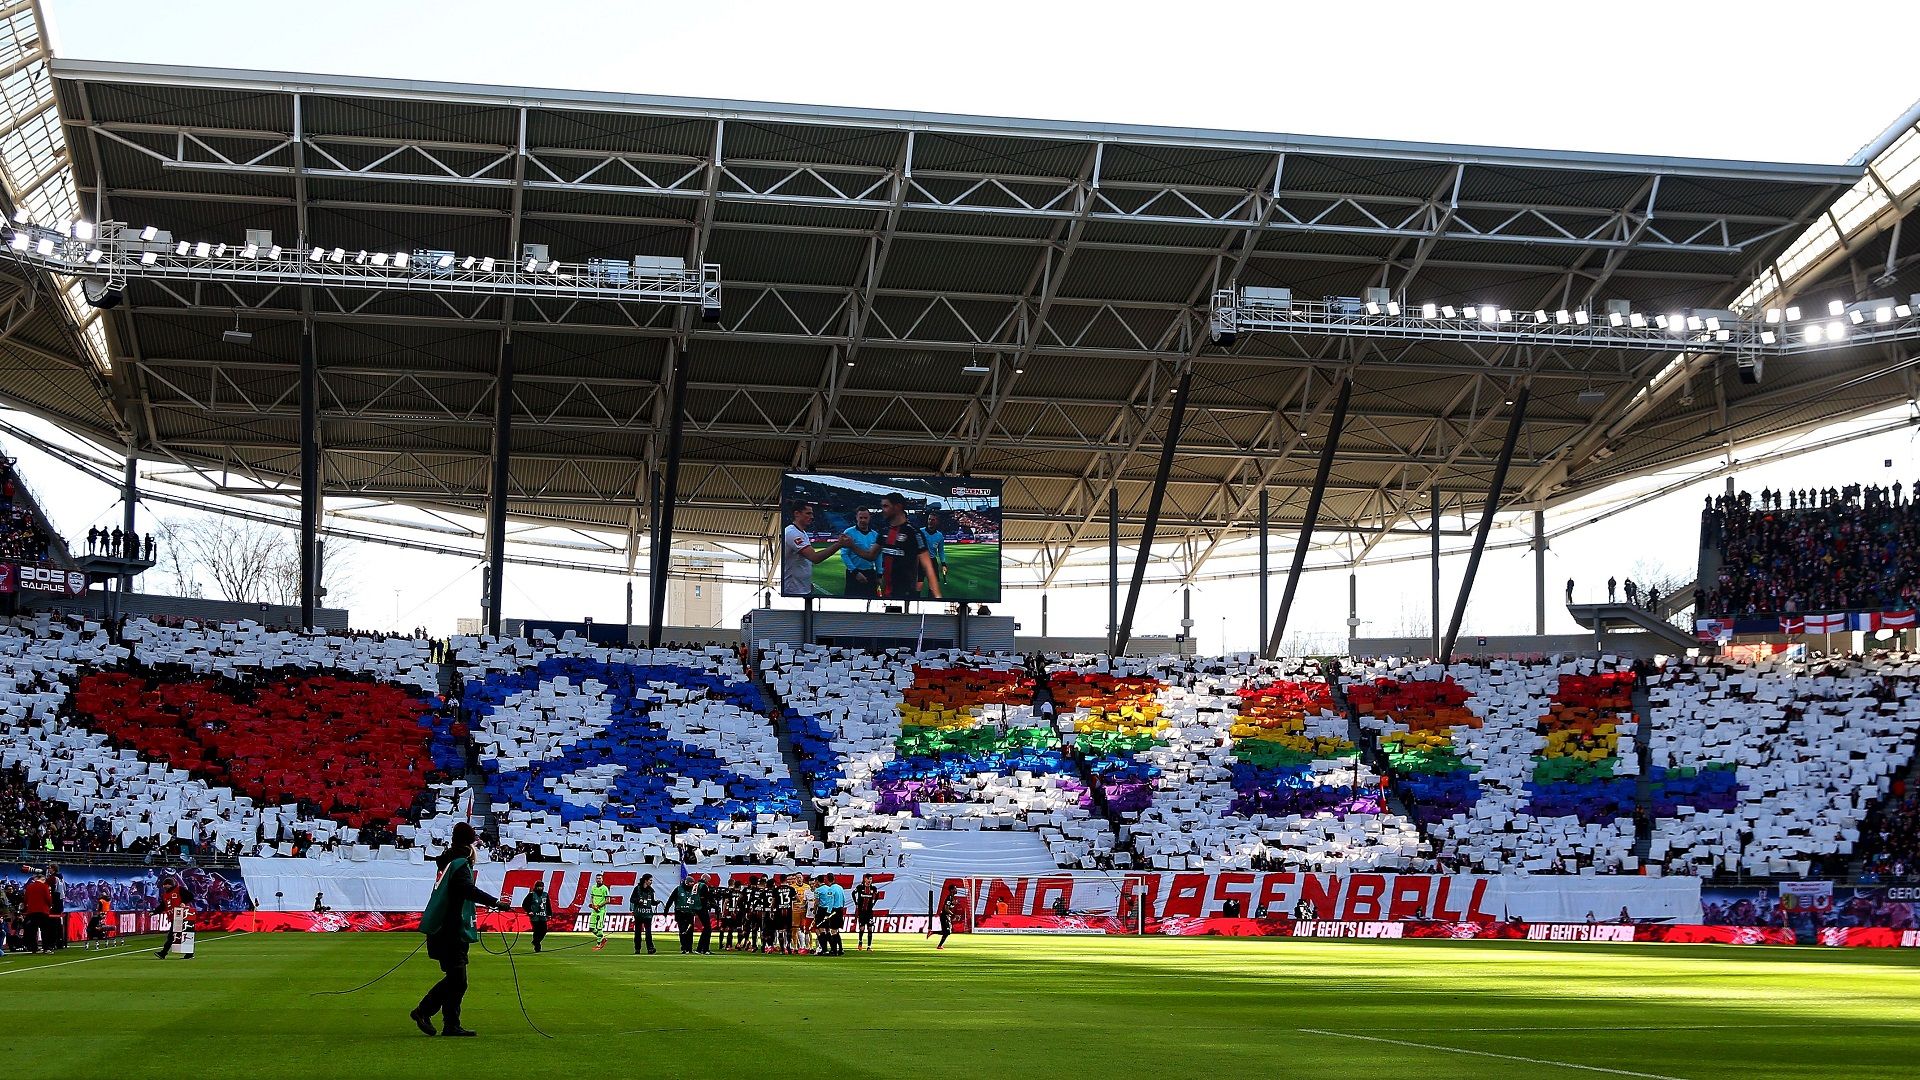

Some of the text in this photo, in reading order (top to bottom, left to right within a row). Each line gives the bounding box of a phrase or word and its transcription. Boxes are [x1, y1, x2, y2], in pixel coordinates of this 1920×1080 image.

[20, 565, 65, 583] BOS
[21, 581, 65, 592] GAURUS
[462, 868, 638, 914] OVE
[935, 873, 1074, 916] AND
[1116, 872, 1498, 923] RASENBALL
[779, 892, 791, 905] 13
[600, 915, 638, 932] GEHT'
[1293, 921, 1317, 937] AUF
[1316, 921, 1357, 938] GEHT'S
[1527, 924, 1551, 940] AUF
[1549, 924, 1590, 940] GEHT'S
